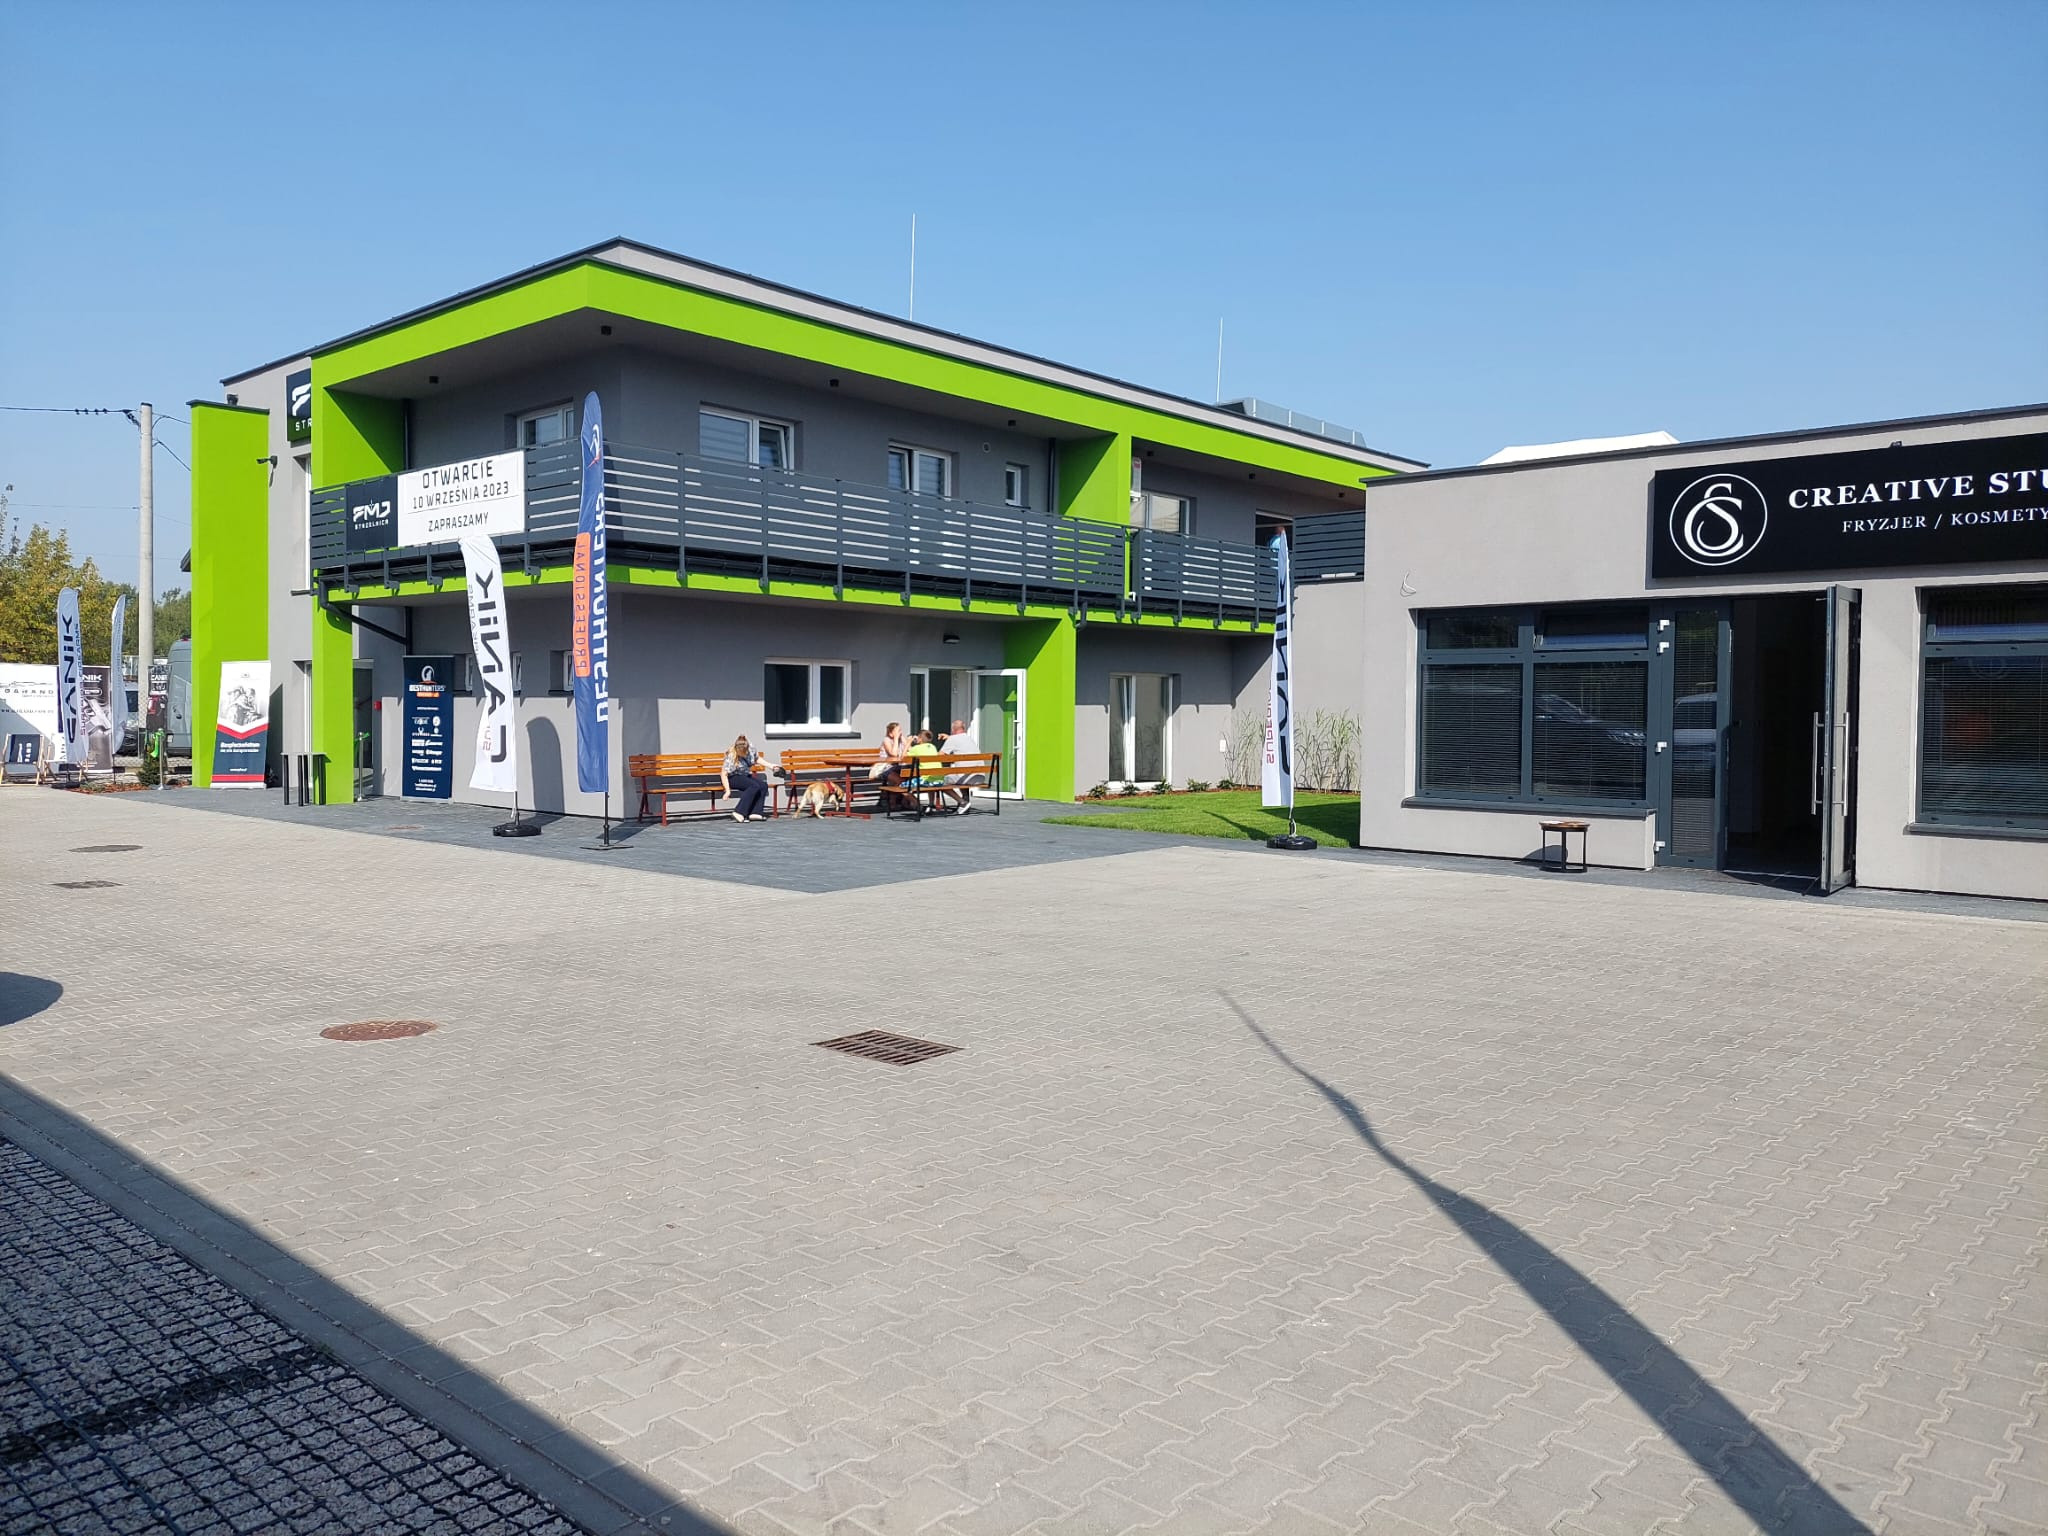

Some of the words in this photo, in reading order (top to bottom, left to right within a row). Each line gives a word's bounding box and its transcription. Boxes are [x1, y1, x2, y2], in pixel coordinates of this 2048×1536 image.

[422, 460, 494, 489] OTWARCIE
[413, 495, 424, 509] 10
[426, 486, 480, 508] WRZEŚNIA
[483, 481, 509, 497] 2023
[1788, 475, 1974, 508] CREATIVE
[428, 512, 489, 532] ZAPRASZAMY
[1842, 515, 1928, 532] FRYZJER
[1934, 513, 1943, 530] /
